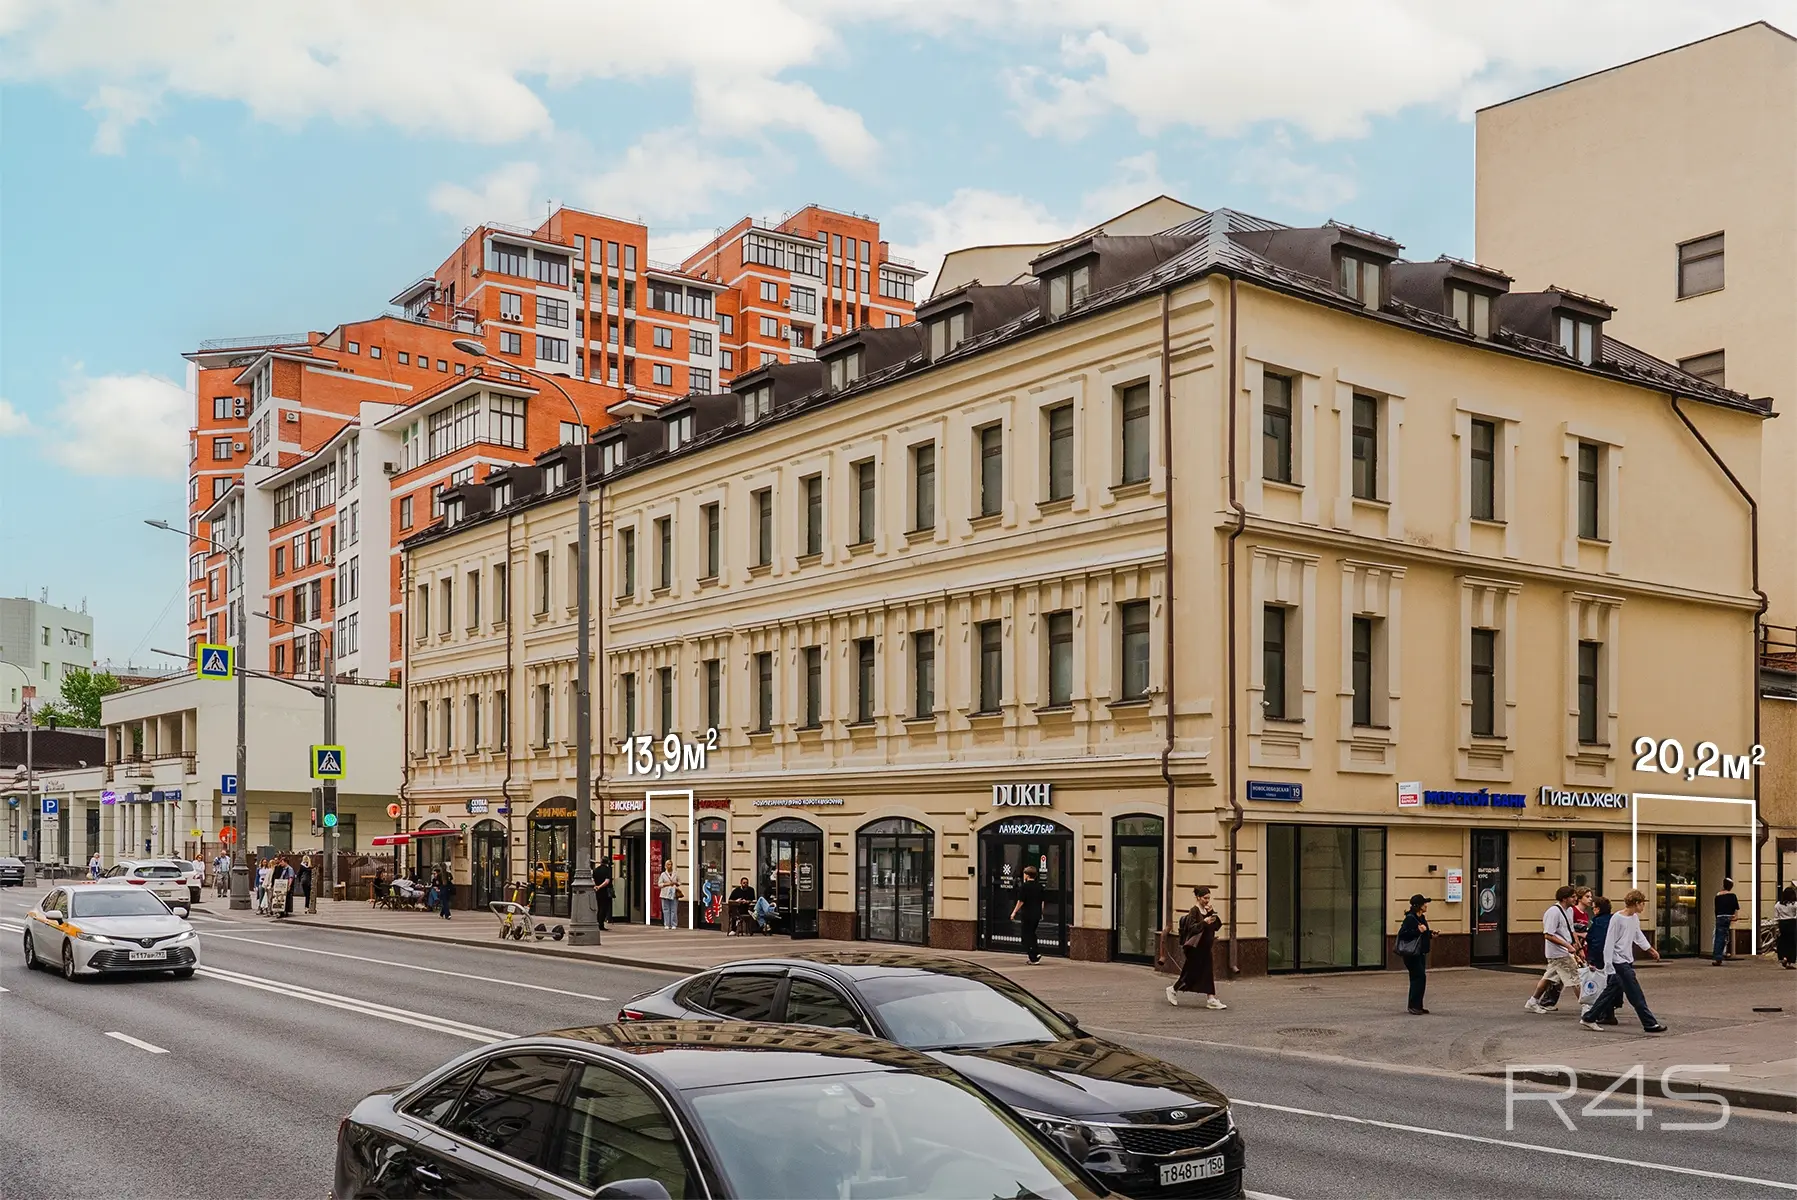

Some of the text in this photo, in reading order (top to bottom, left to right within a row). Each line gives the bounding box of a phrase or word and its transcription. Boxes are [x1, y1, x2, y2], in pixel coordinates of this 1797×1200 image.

[992, 783, 1051, 806] DUKH
[1293, 788, 1300, 797] 19
[1424, 788, 1527, 808] МОРСКОЙ БАНК
[46, 801, 56, 812] P
